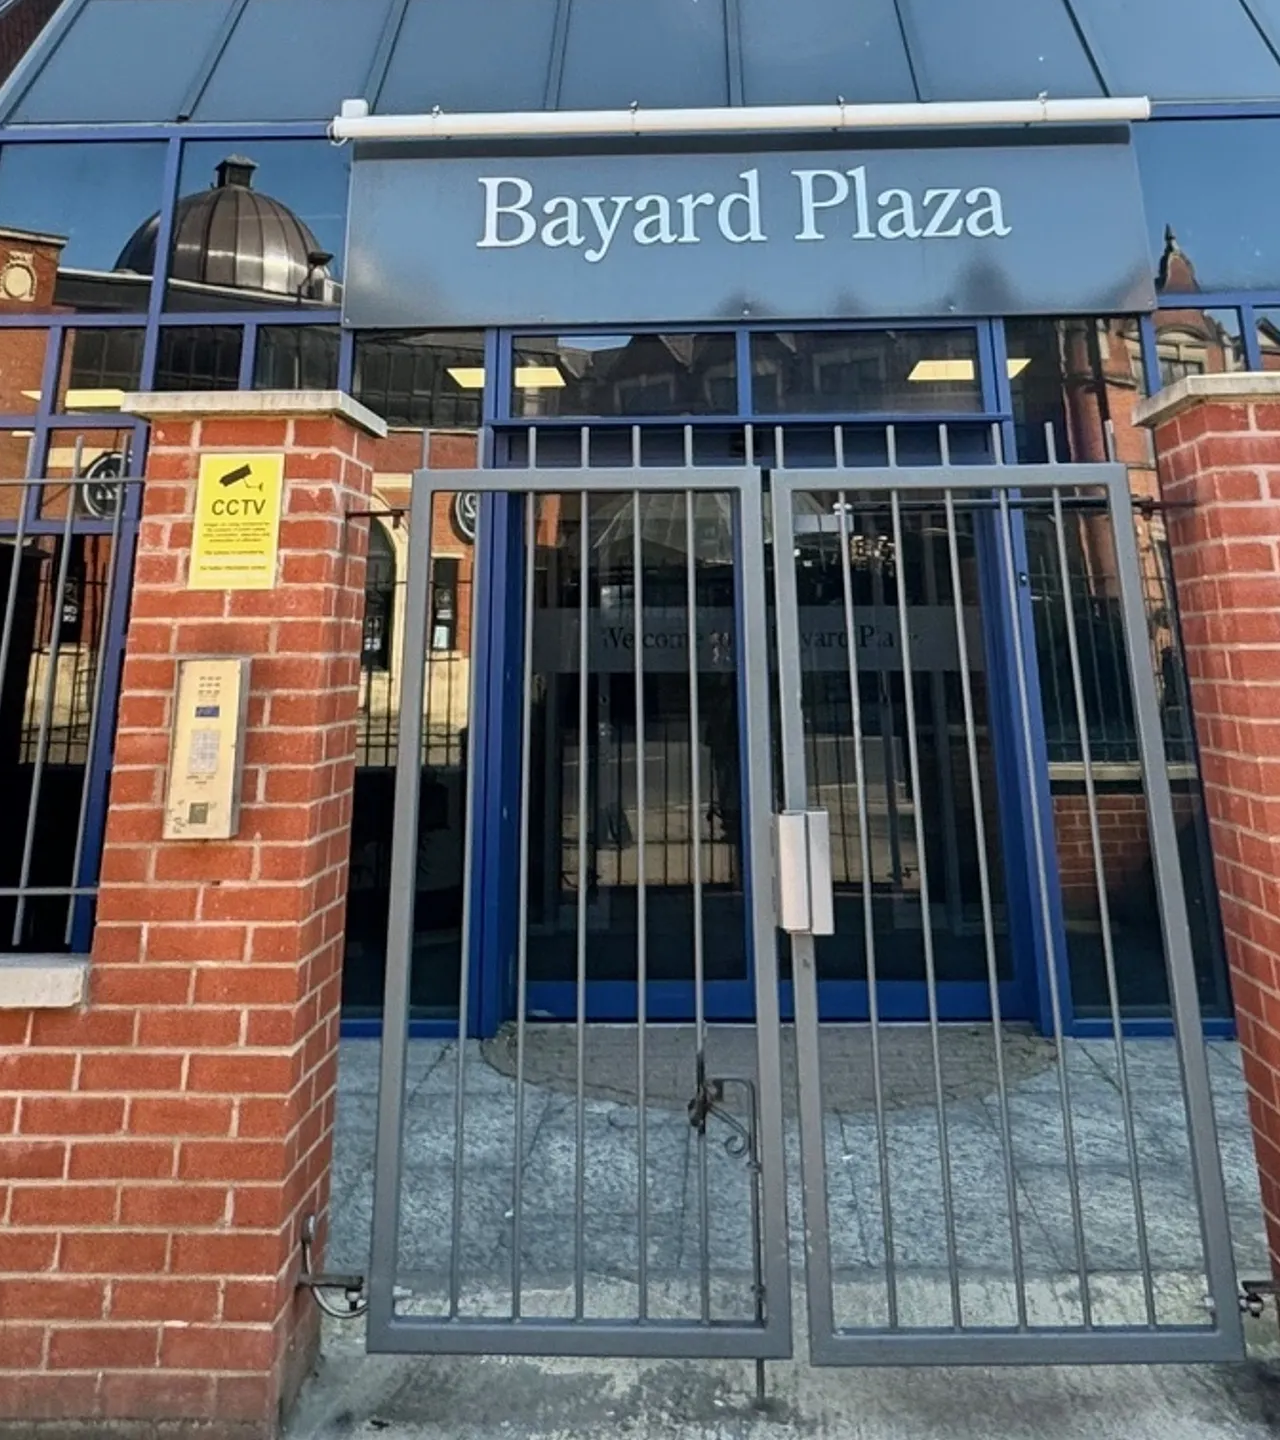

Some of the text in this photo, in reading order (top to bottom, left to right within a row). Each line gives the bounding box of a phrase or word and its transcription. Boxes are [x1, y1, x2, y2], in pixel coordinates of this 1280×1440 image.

[476, 165, 1013, 263] Bayard Plaza
[211, 498, 267, 516] CCTV
